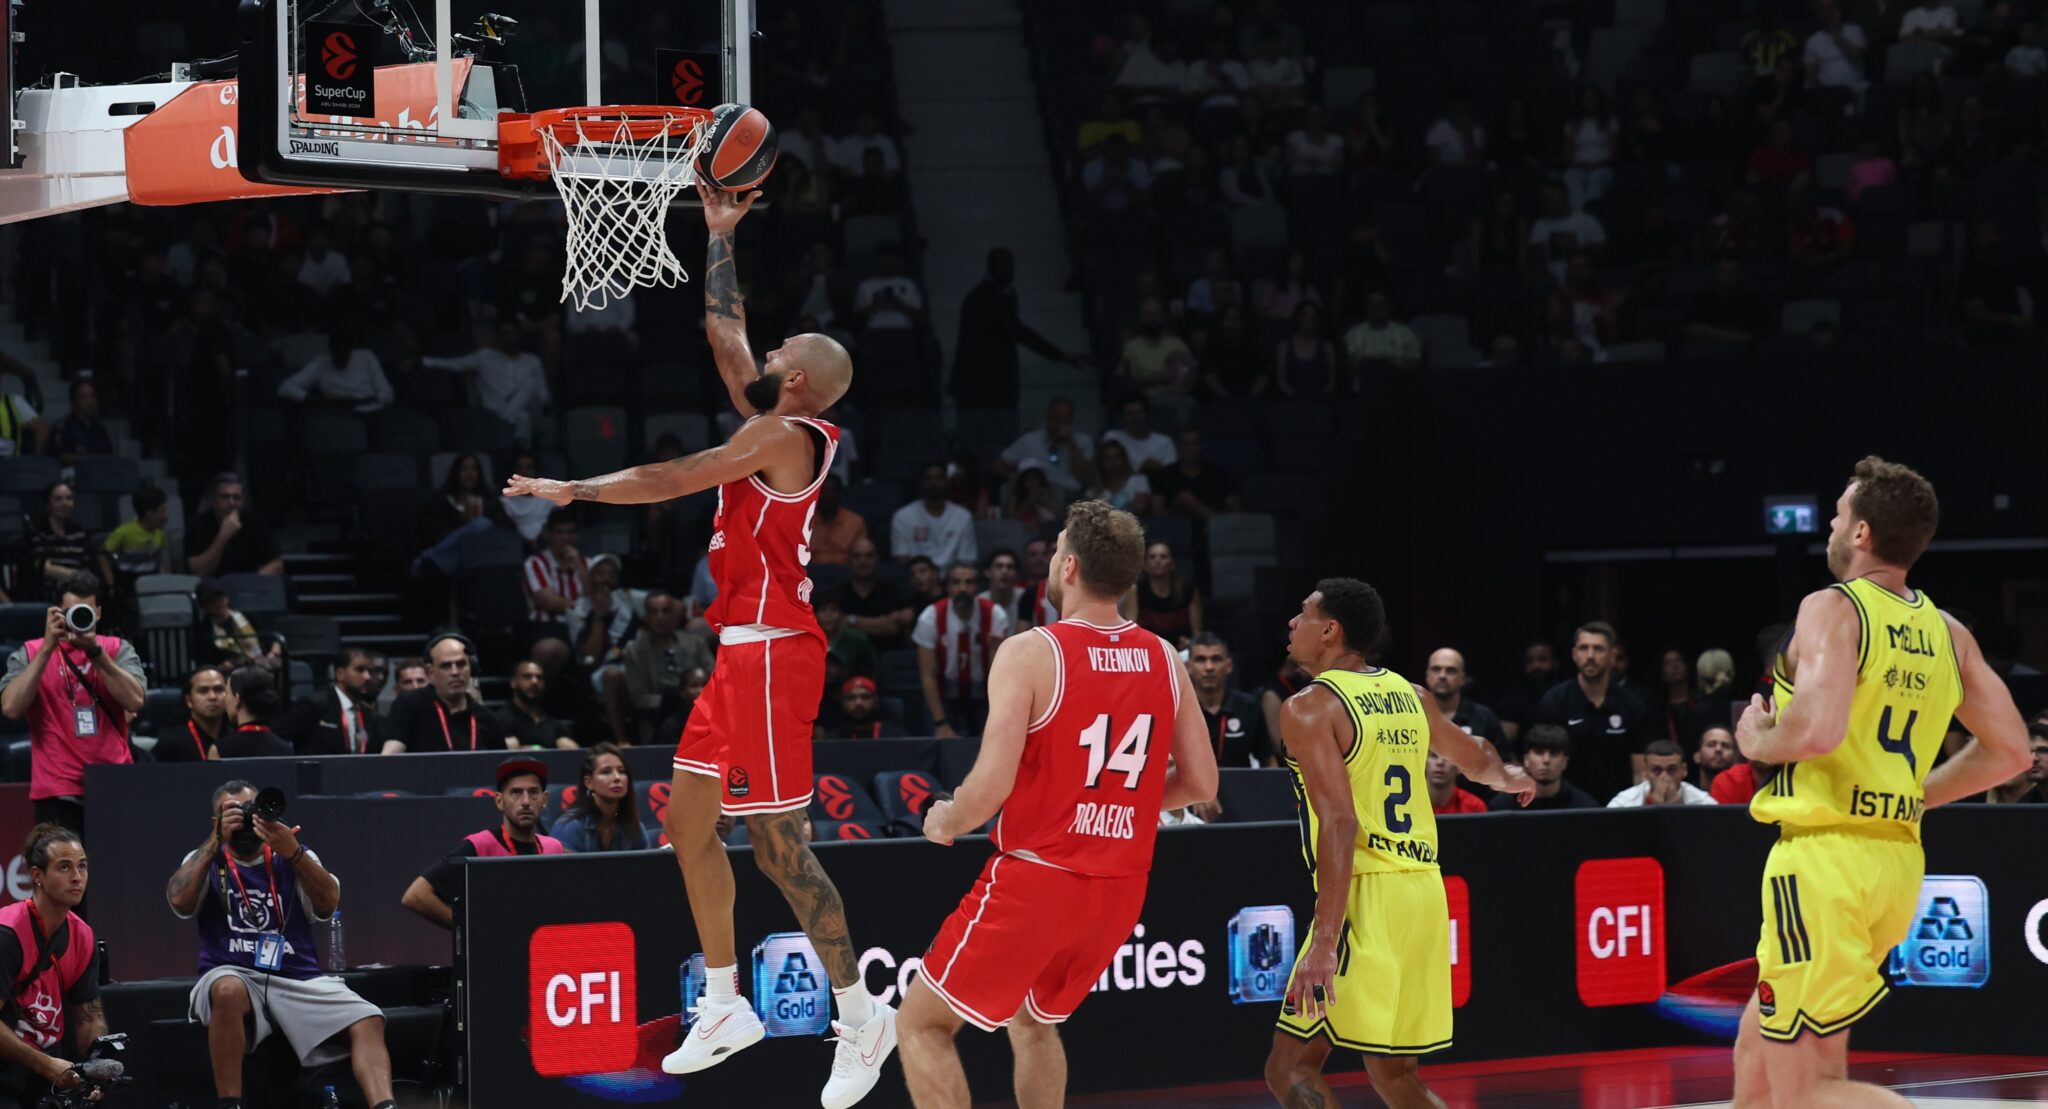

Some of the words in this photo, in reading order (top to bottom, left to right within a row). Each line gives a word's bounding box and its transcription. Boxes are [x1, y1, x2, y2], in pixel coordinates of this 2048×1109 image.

[314, 84, 366, 101] SuperCup
[289, 140, 339, 156] SPALDING
[1087, 646, 1151, 672] VEZENKOV
[1386, 728, 1418, 746] MSC
[1877, 705, 1918, 780] 4
[1078, 713, 1154, 791] 14
[1384, 764, 1413, 834] 2
[1588, 904, 1652, 960] CFI
[229, 938, 295, 955] MEA
[1919, 946, 1970, 968] Gold
[1256, 972, 1277, 992] Oil
[545, 970, 622, 1028] CFI
[777, 997, 815, 1020] Gold
